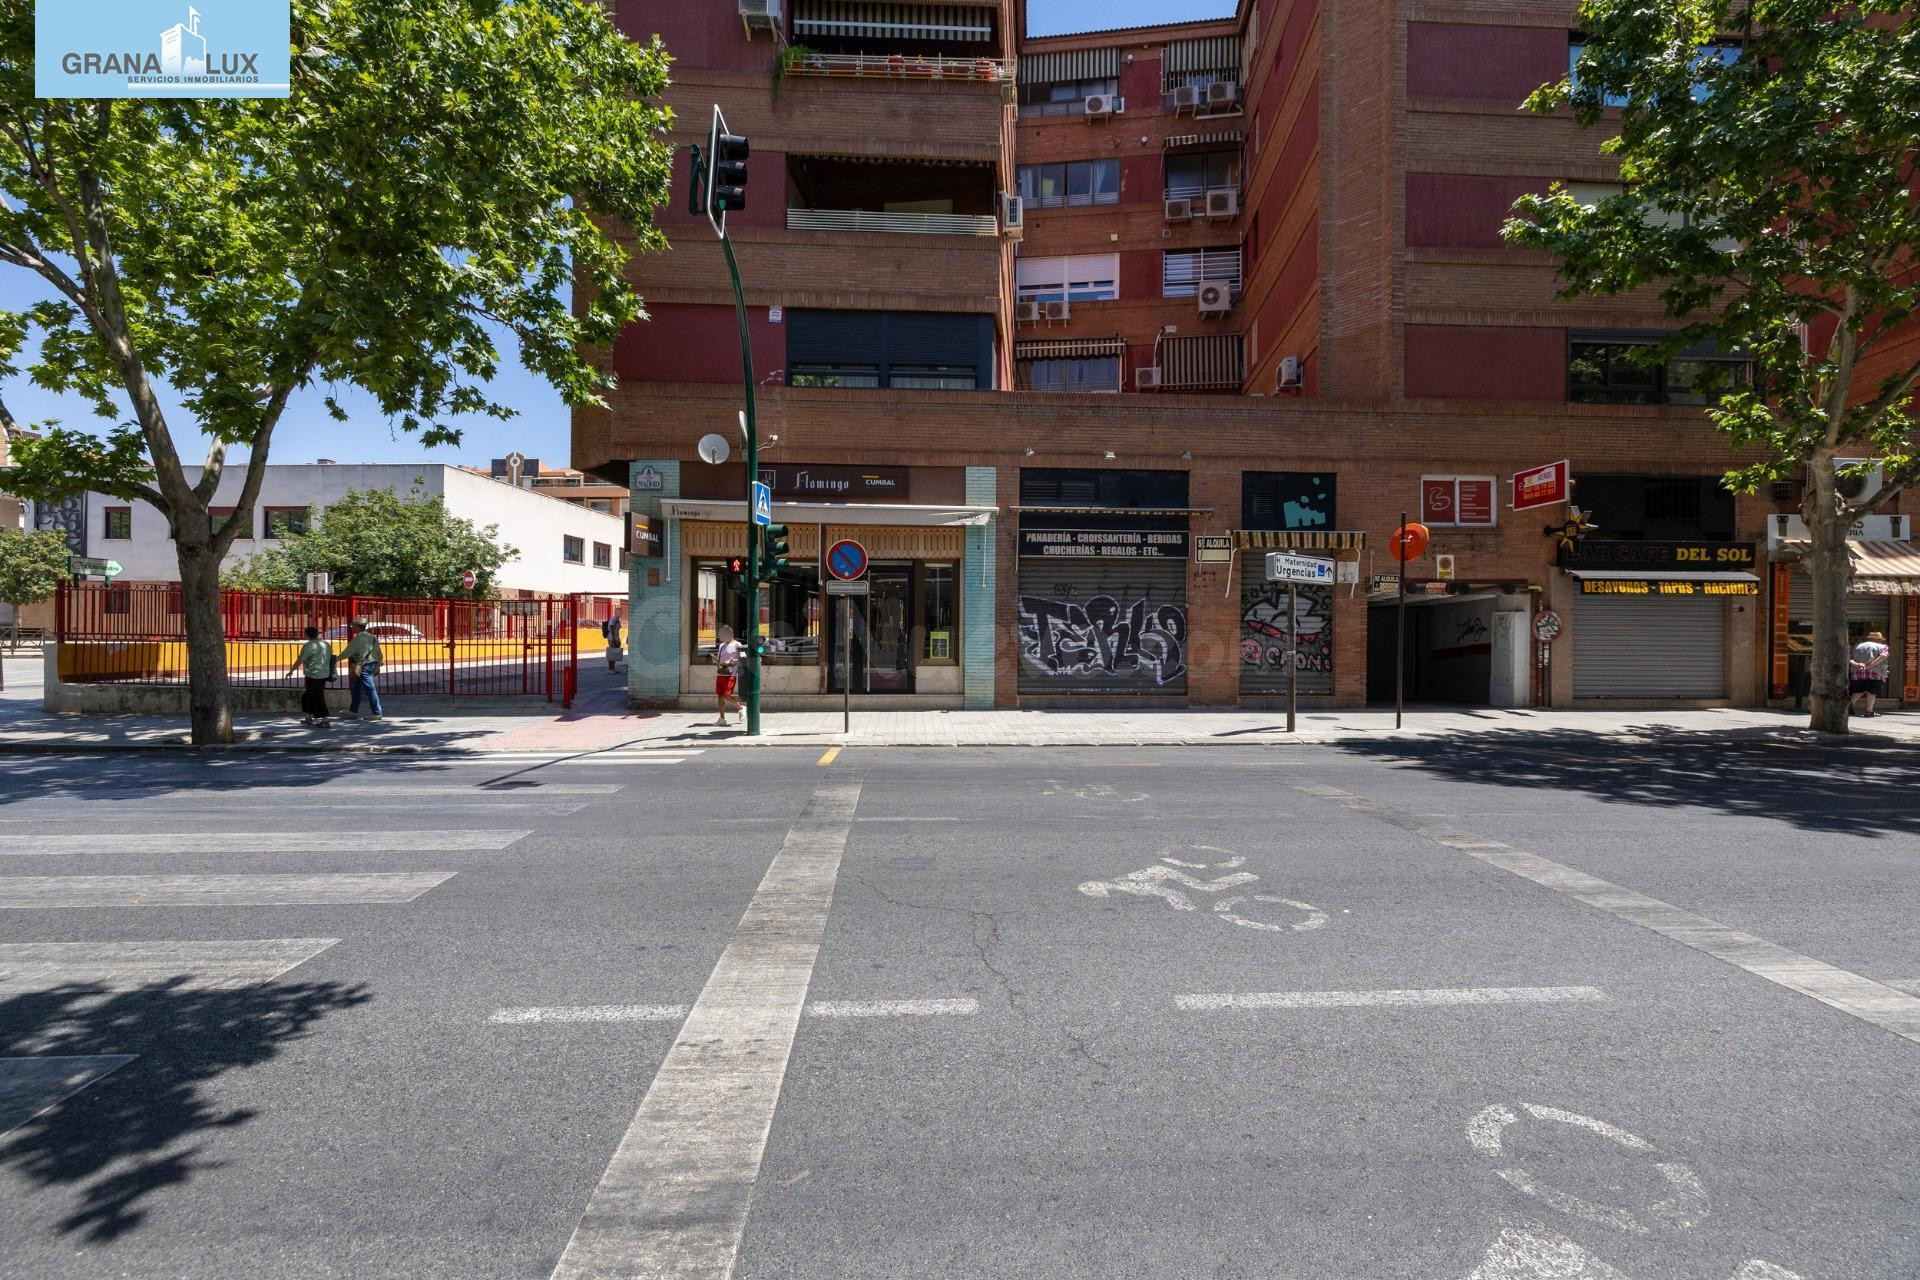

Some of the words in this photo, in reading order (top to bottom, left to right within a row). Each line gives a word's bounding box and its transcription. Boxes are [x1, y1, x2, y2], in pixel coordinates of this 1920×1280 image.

[793, 471, 849, 491] Flamingo
[636, 530, 660, 542] CUMBAL
[1026, 532, 1071, 543] PANADERÍA
[1077, 532, 1141, 544] CROISSANTERÍA
[1147, 534, 1182, 544] BEBIDAS
[1206, 538, 1230, 549] ALQUILA
[1043, 544, 1095, 555] CHUCHERÍAS
[1101, 546, 1137, 556] REGALOS
[1676, 548, 1711, 561] DEL
[1717, 548, 1752, 562] SOL
[1276, 565, 1316, 578] Urgencias
[1584, 580, 1649, 594] DESAYUNOS
[1658, 582, 1694, 594] TAPAS
[1704, 582, 1758, 595] RACIONES
